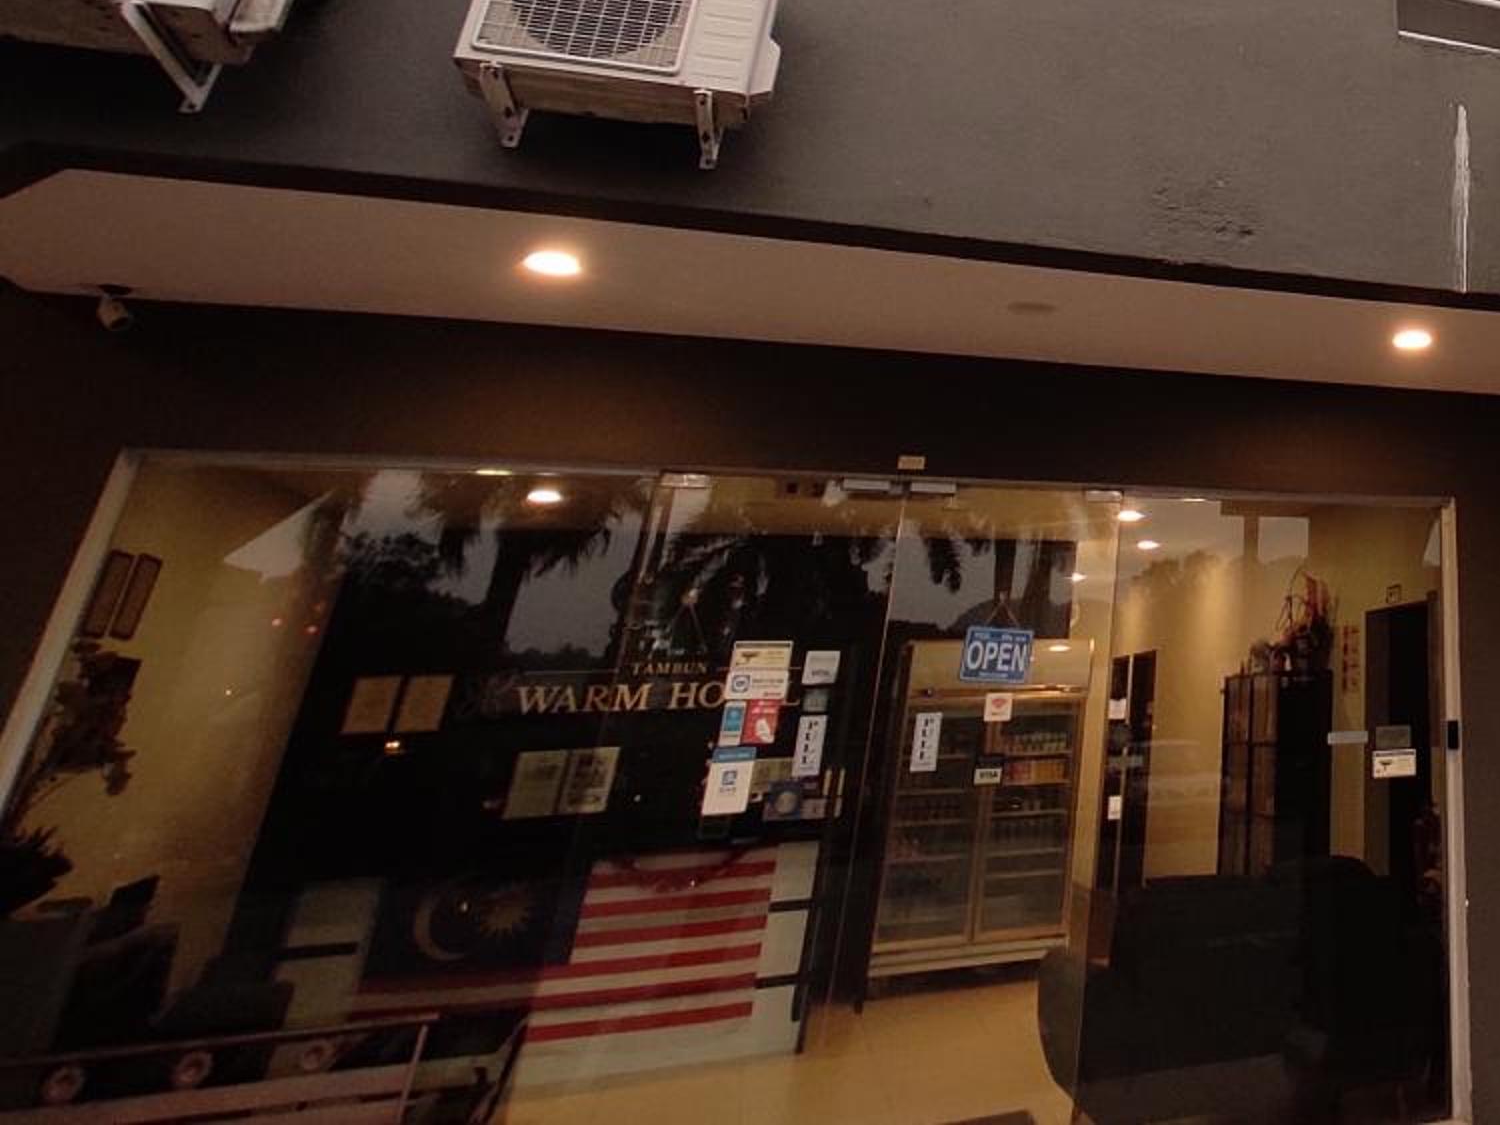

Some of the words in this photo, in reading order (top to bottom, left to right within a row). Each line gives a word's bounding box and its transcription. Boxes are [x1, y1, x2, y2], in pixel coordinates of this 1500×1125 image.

[631, 661, 708, 675] TAMBUN
[966, 640, 1028, 672] OPEN
[516, 682, 653, 715] WARM
